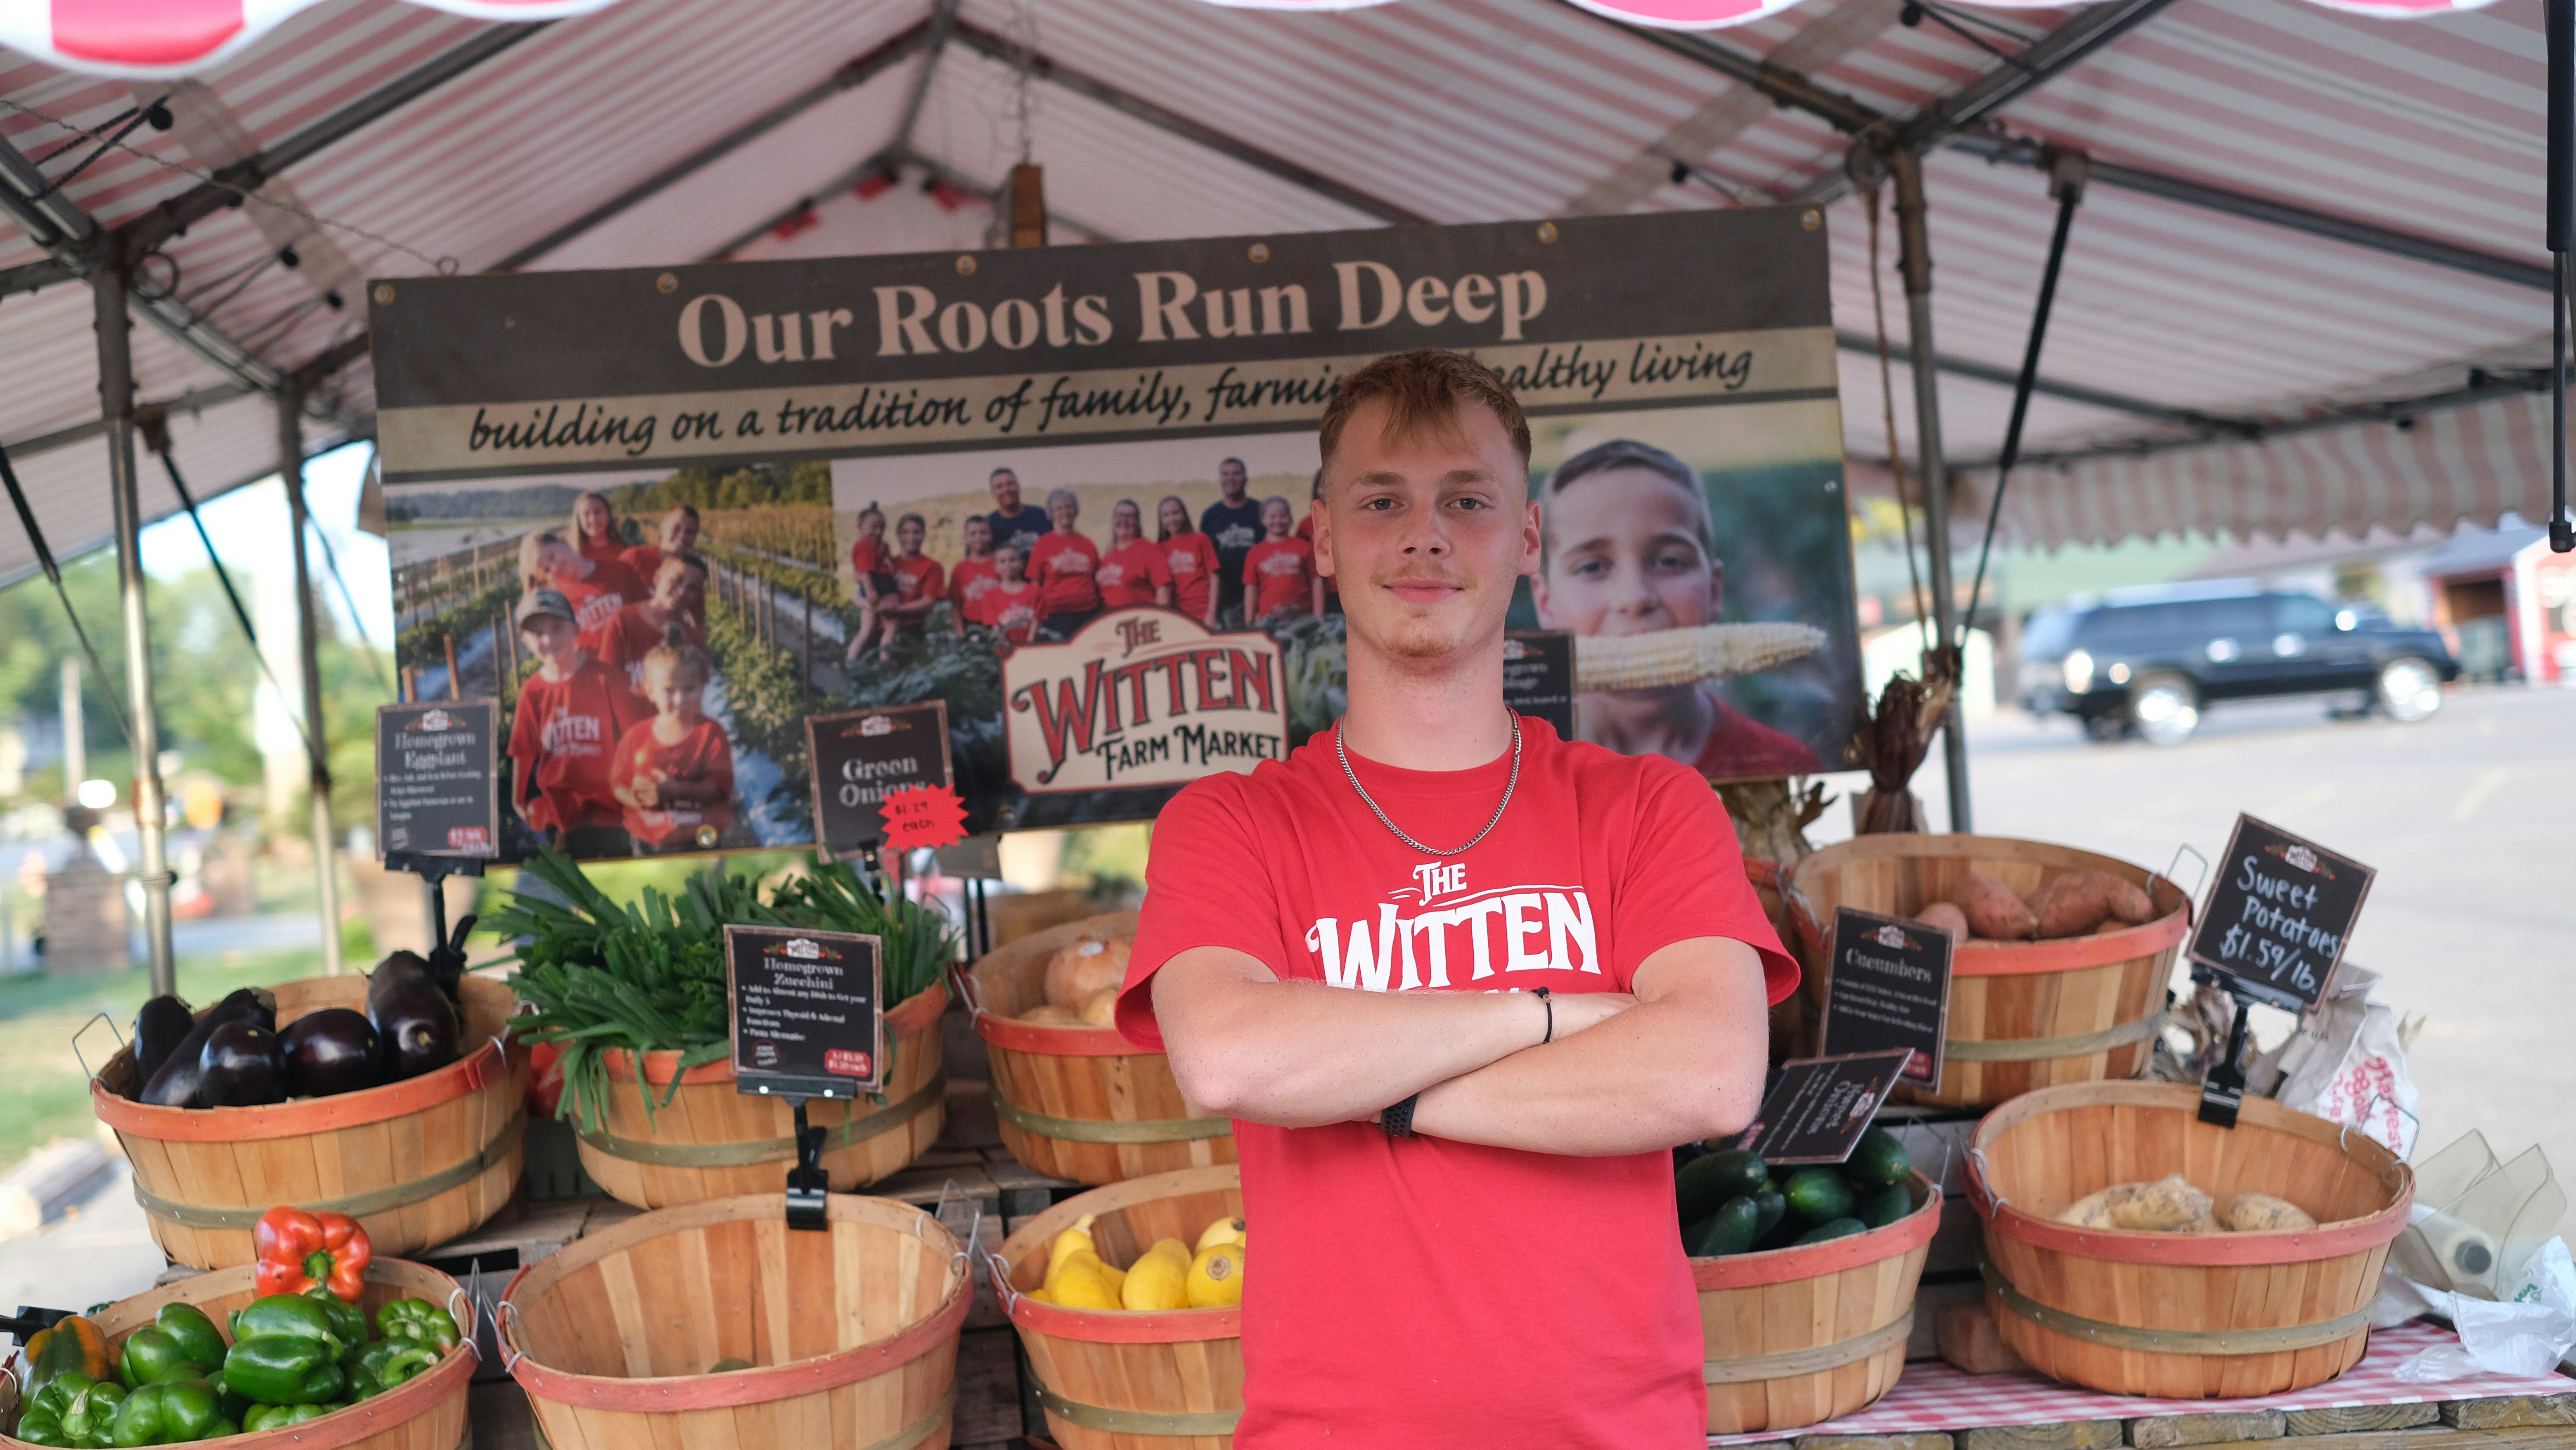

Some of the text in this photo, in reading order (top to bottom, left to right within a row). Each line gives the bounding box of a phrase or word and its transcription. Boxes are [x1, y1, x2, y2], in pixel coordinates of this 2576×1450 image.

[677, 260, 1548, 368] Our Roots Run Deep
[469, 402, 657, 456] building
[671, 411, 722, 442] on
[737, 409, 765, 438] a
[776, 386, 971, 436] tradition
[984, 379, 1034, 433] of
[1038, 372, 1192, 432] family,
[1206, 363, 1342, 416] farmi
[1629, 341, 1754, 391] living
[1115, 616, 1162, 657] THE
[1011, 647, 1278, 784] WITTEN
[842, 756, 919, 781] Green
[1096, 723, 1281, 781] FARM MARKET
[902, 819, 935, 833] each
[1412, 861, 1468, 906] THE
[2236, 855, 2319, 911] Sweet
[1305, 891, 1601, 992] WITTEN
[2242, 895, 2341, 959] Potatoes
[762, 956, 845, 978] Homegrown
[774, 972, 834, 991] Zucchini
[1845, 947, 1932, 983] Cucumbers
